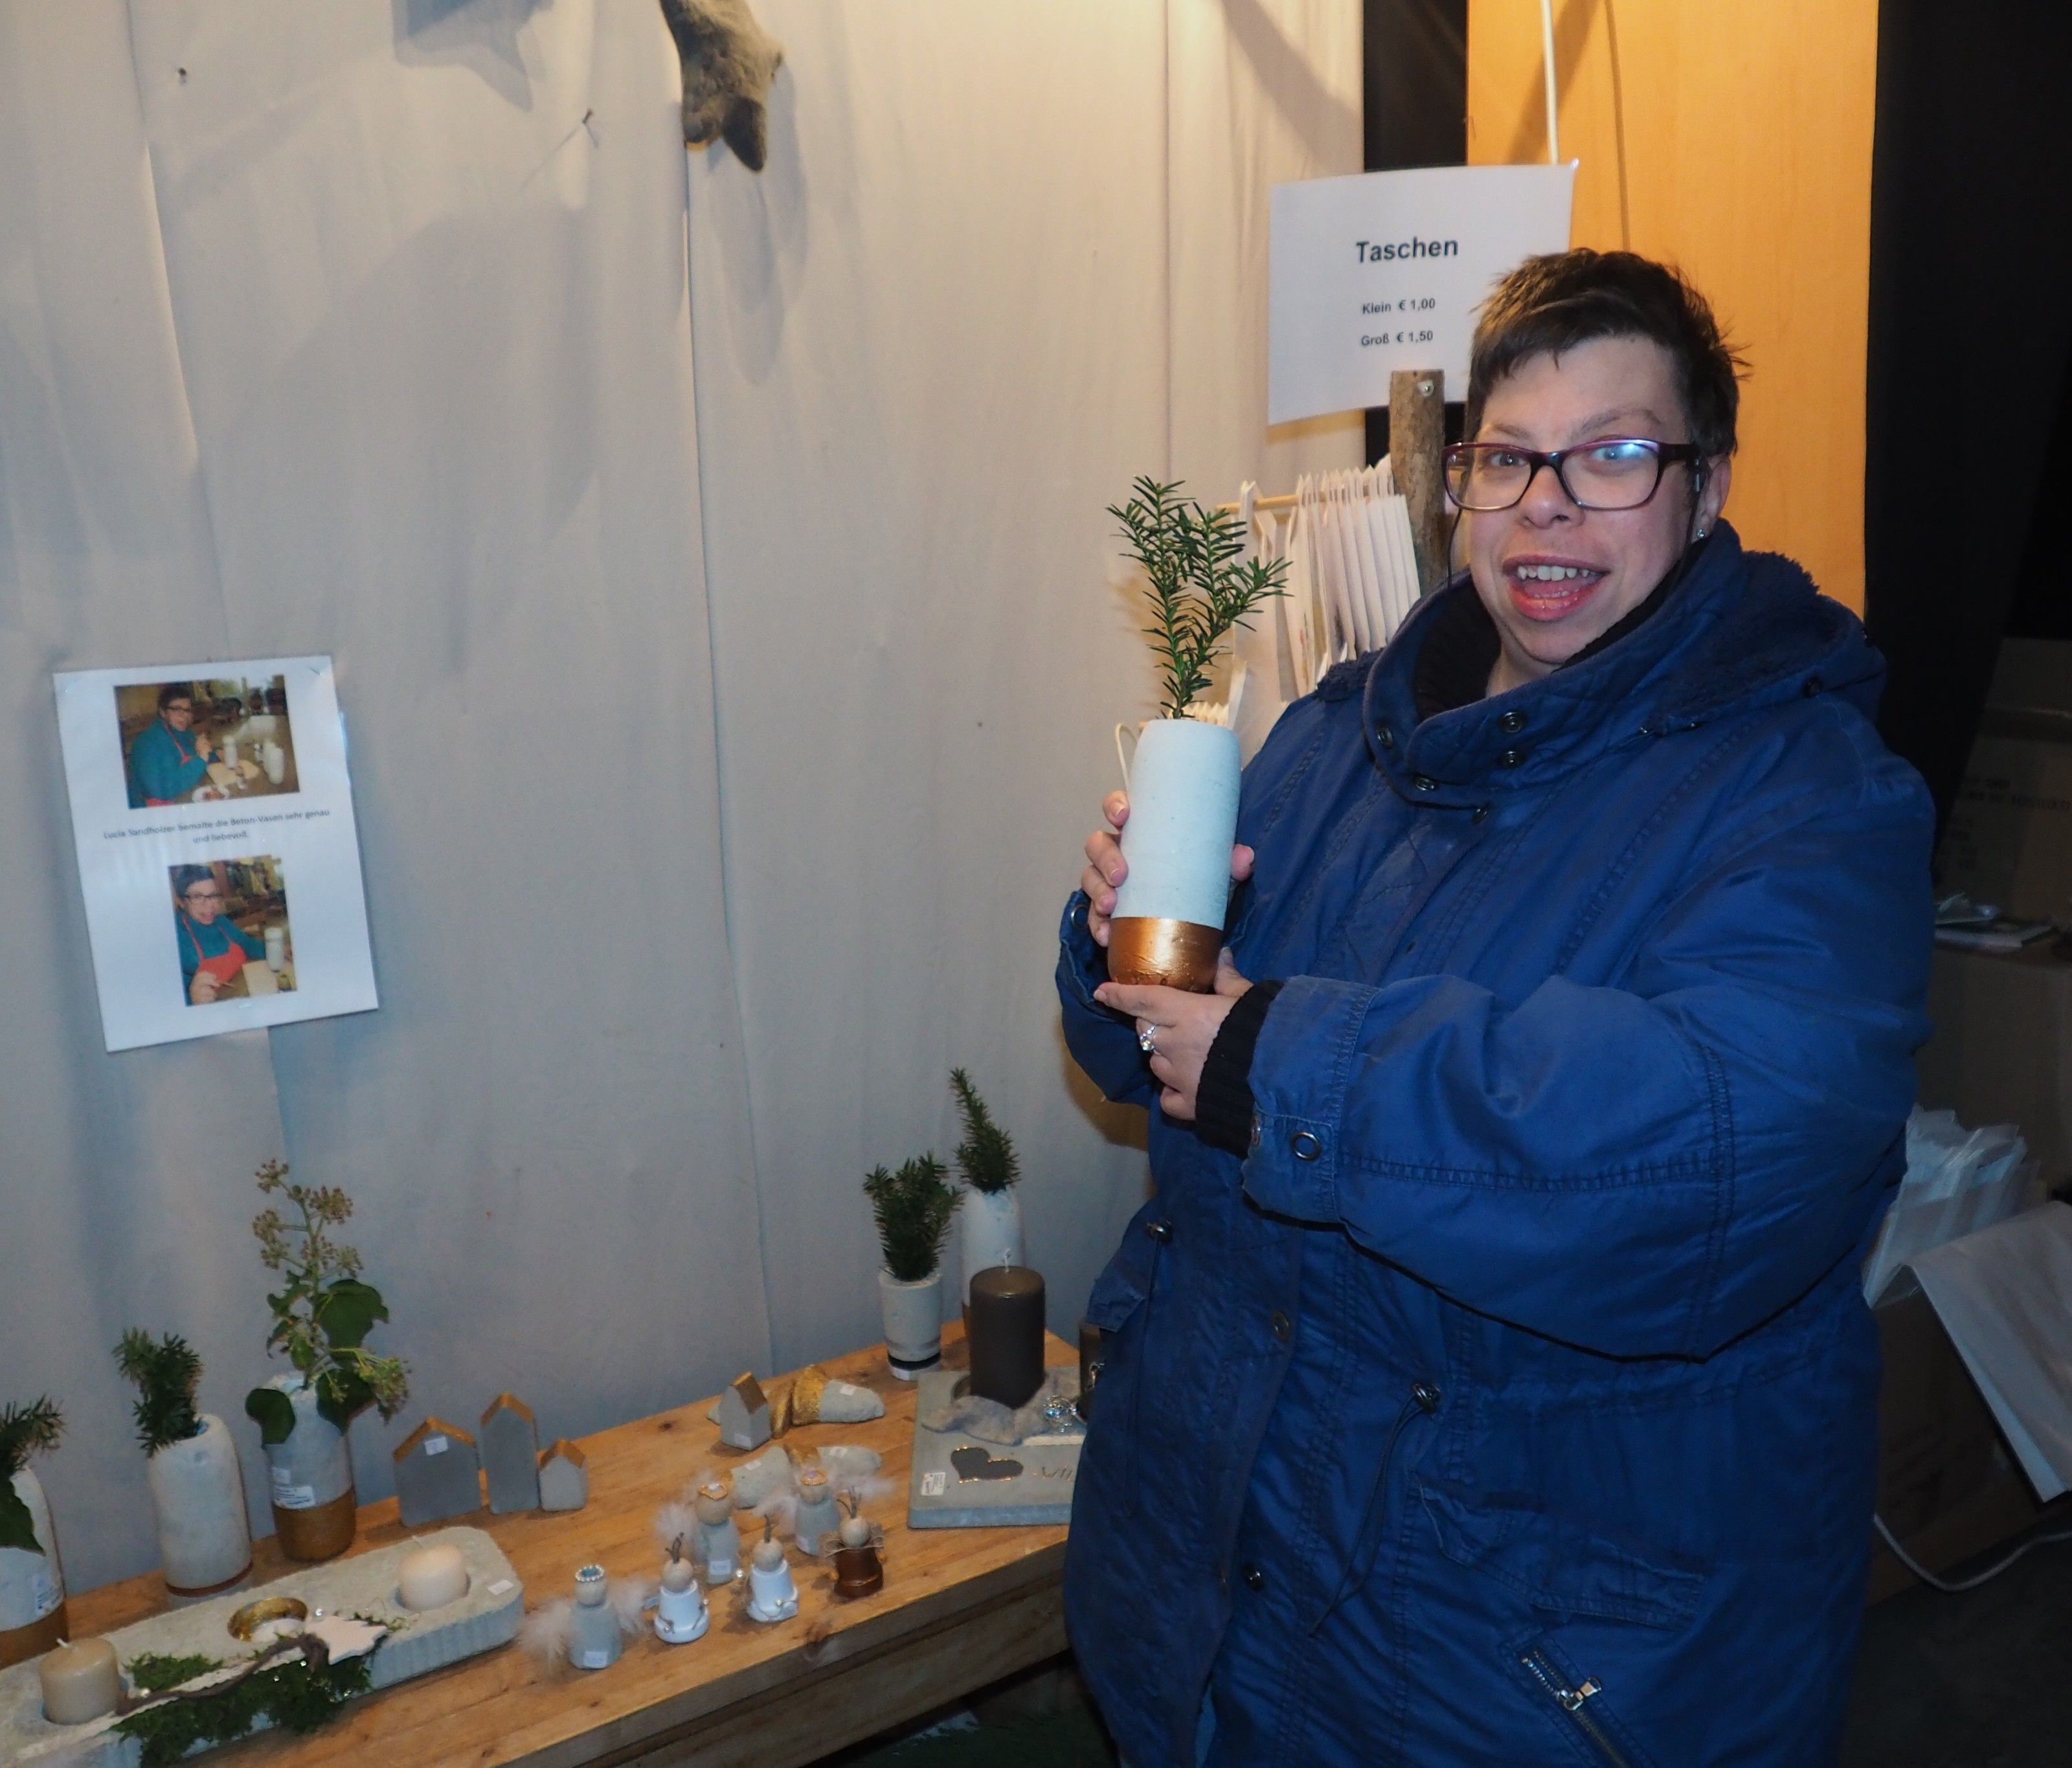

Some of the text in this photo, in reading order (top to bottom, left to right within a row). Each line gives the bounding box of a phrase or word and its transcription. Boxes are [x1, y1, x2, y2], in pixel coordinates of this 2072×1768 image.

[1356, 236, 1458, 263] Taschen
[1362, 298, 1436, 314] Klein € 1,00
[1361, 330, 1433, 347] Groß € 1,50
[216, 819, 229, 827] die
[231, 814, 283, 825] Beton-Vasen
[285, 811, 302, 820] sehr
[304, 809, 330, 820] genau
[192, 834, 210, 844] und
